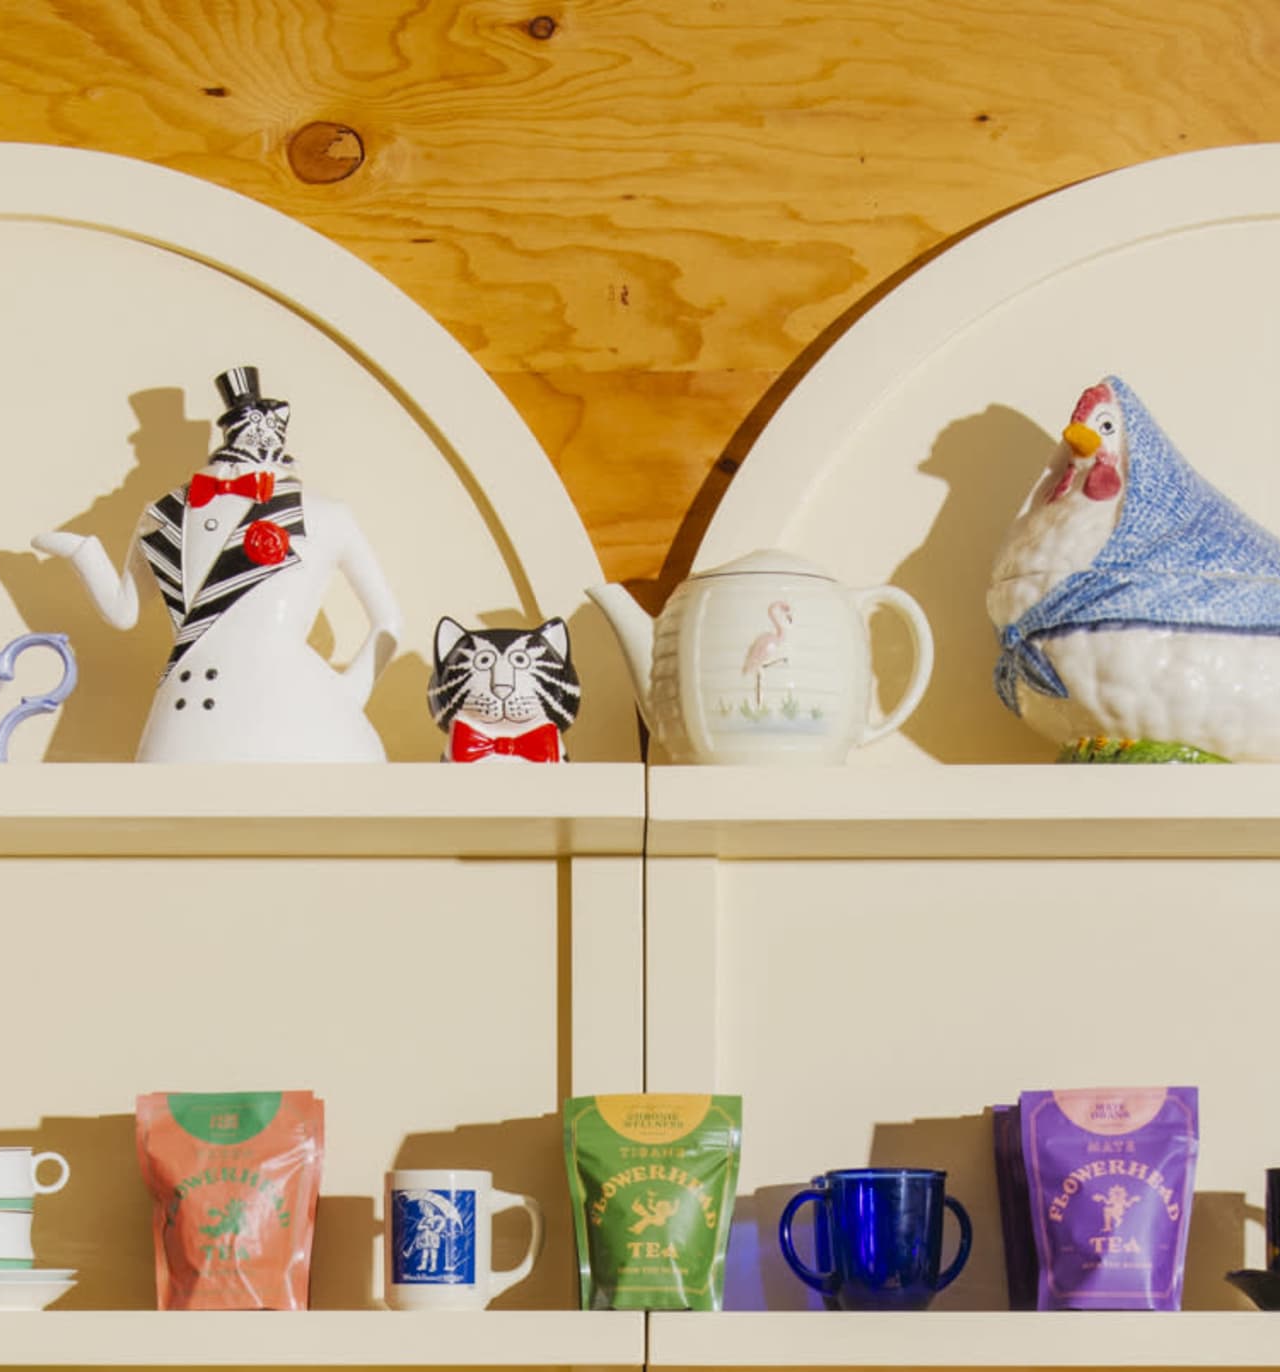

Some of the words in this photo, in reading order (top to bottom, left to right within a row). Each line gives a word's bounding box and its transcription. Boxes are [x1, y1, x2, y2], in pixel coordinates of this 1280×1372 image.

[1049, 1159, 1181, 1222] FLOWERHEAD
[627, 1242, 679, 1259] TEA
[1089, 1237, 1141, 1254] TEA
